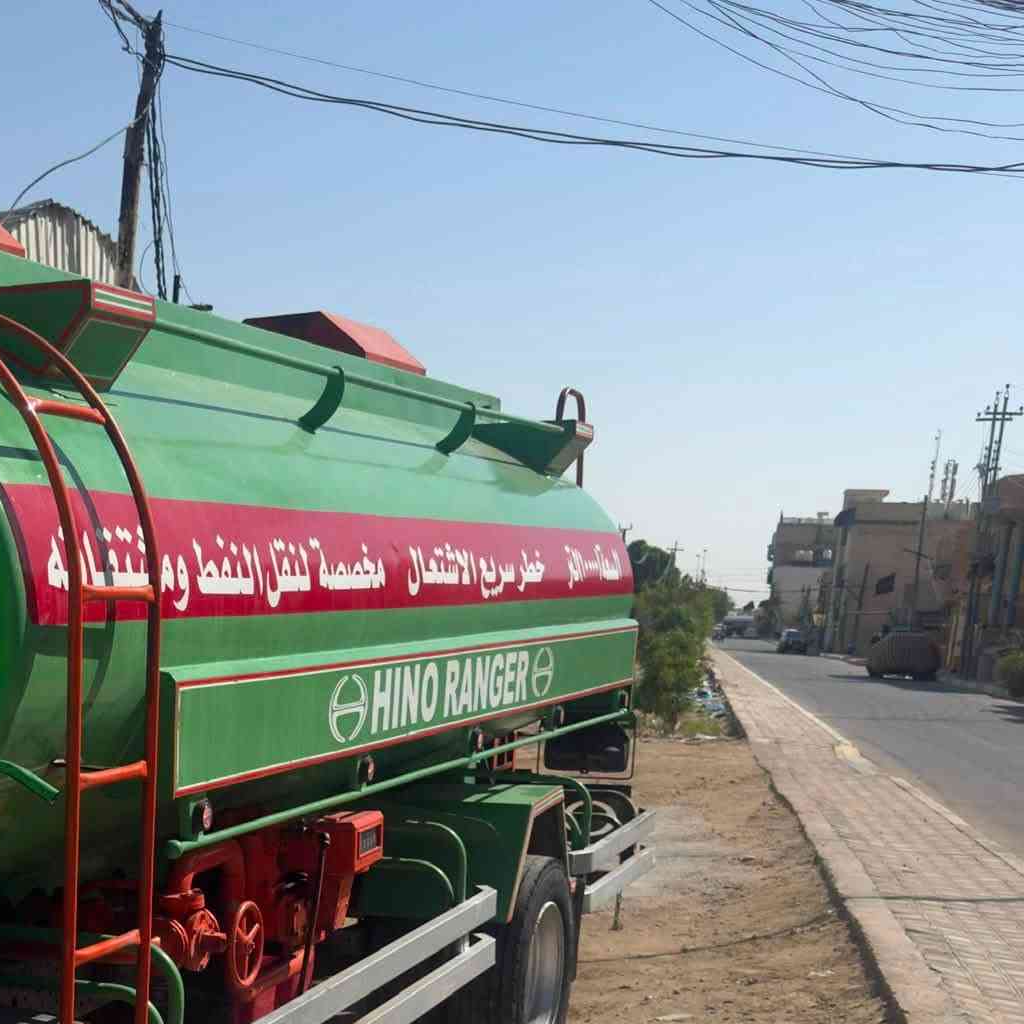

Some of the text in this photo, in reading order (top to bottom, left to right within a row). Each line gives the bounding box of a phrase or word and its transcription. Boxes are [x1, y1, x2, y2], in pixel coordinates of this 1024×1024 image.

[193, 534, 264, 596] النفط
[266, 537, 312, 608] لنقل
[309, 535, 386, 591] مخصصة
[407, 541, 477, 597] الاشتعال
[479, 555, 515, 599] سريع
[517, 548, 545, 592] خطر
[371, 650, 530, 735] HINO RANGER
